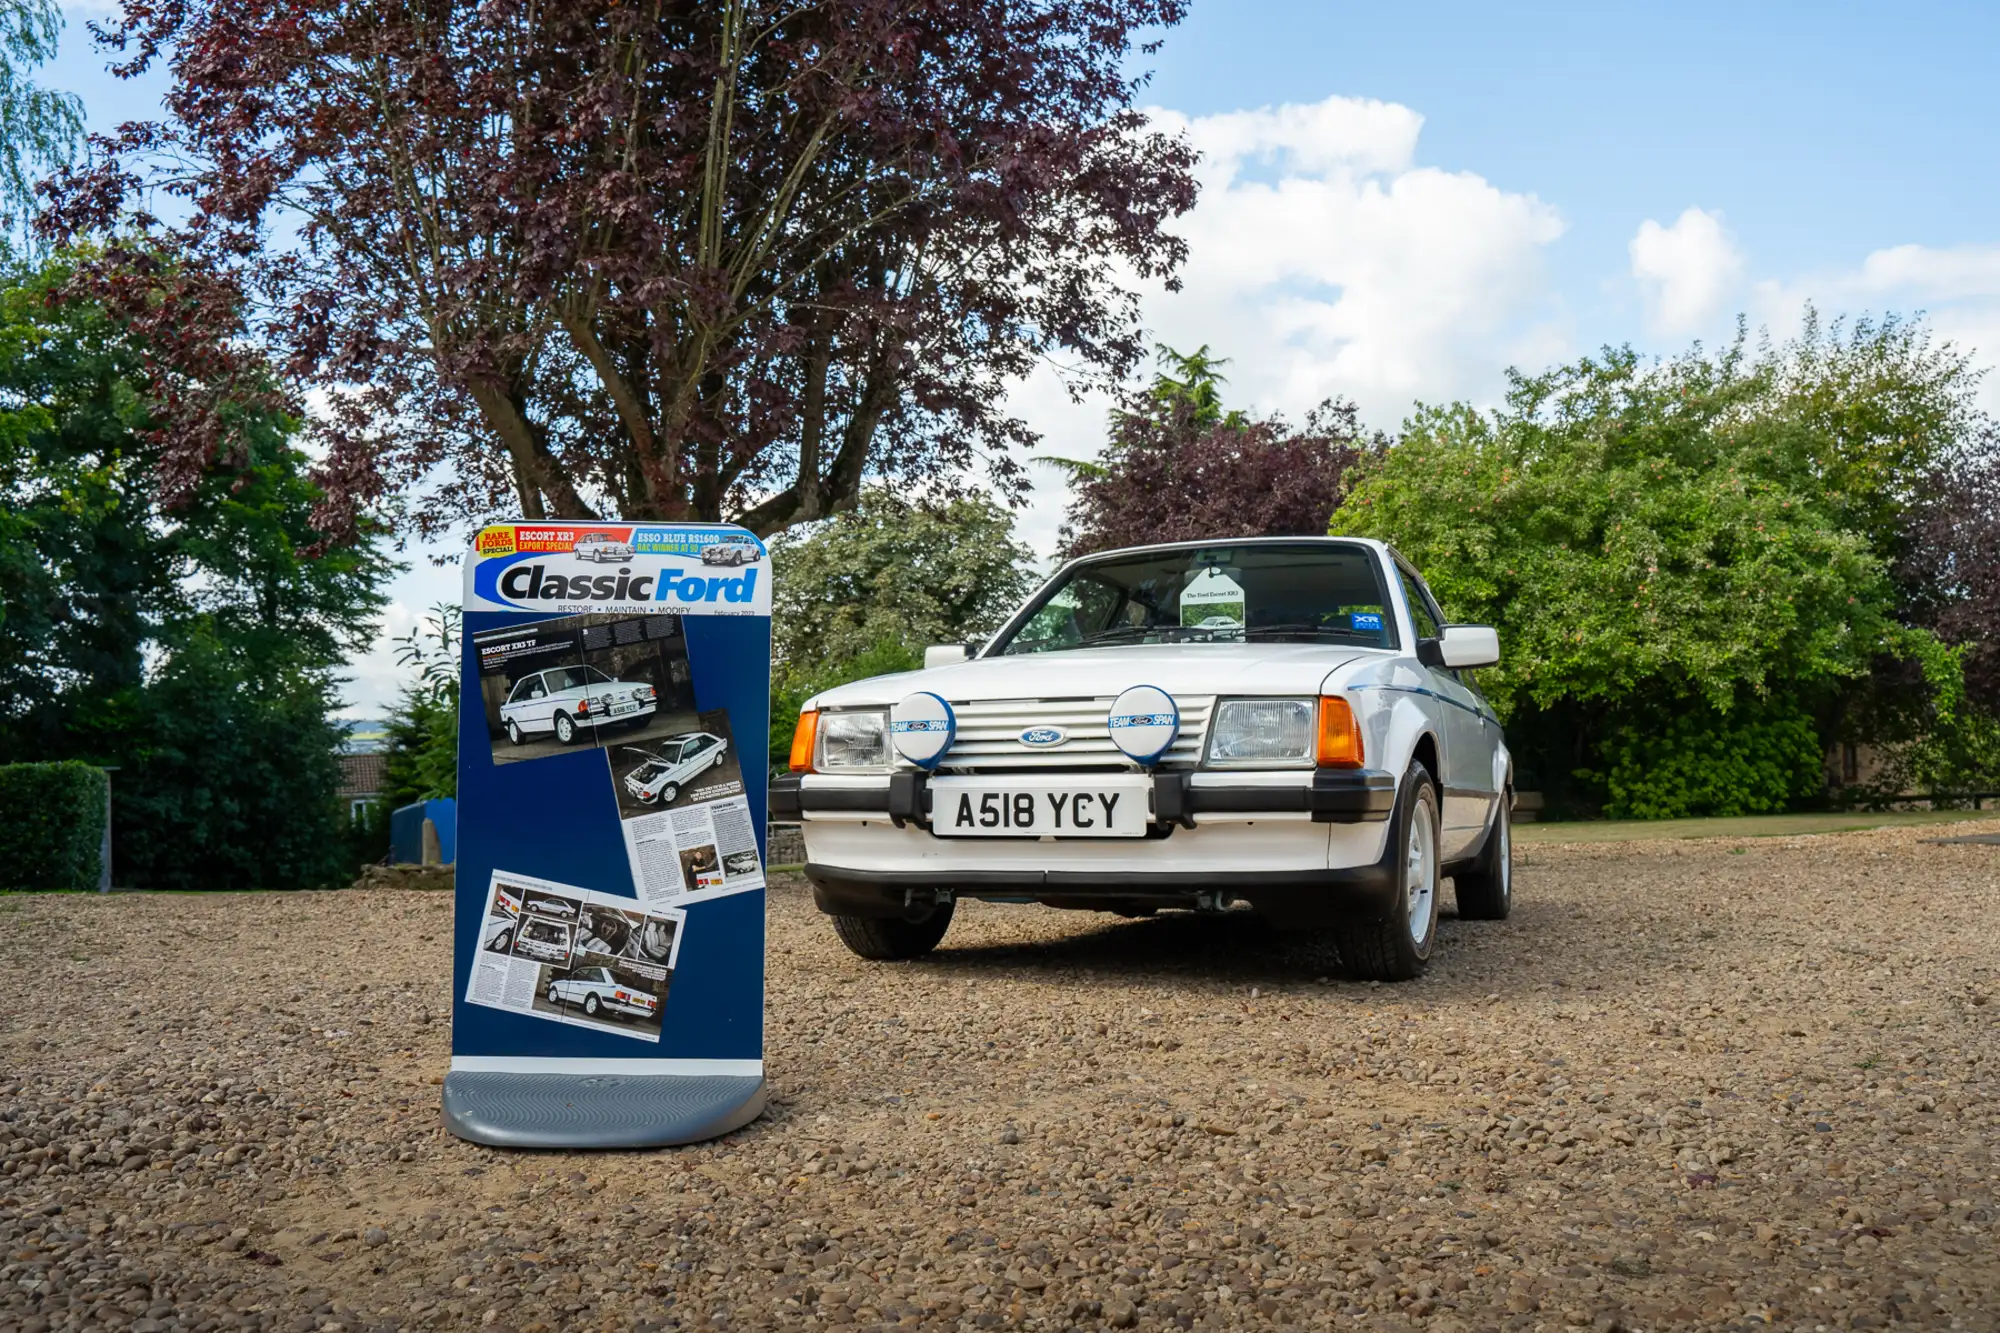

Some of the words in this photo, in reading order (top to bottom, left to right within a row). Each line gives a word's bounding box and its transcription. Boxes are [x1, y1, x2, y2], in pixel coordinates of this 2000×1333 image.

[484, 532, 510, 540] RARE
[519, 531, 555, 541] ESCORT
[556, 532, 575, 541] XR3
[637, 533, 661, 543] ESSO
[662, 533, 687, 543] BLUE
[688, 534, 720, 544] RS1600
[482, 539, 512, 548] FORDS
[519, 541, 545, 550] EXPORT
[546, 541, 573, 551] SPECIAL
[637, 543, 651, 552] RAC
[652, 543, 679, 552] WINNER
[680, 544, 689, 552] AT
[501, 564, 654, 601] Classic
[655, 568, 759, 603] Ford
[557, 604, 593, 613] RESTORE
[605, 606, 647, 614] MAINTAIN
[657, 607, 691, 615] MODIFY
[481, 643, 511, 655] ESCORT
[511, 641, 526, 650] XR3
[891, 721, 908, 732] TEAM
[909, 722, 926, 730] Ford
[928, 719, 948, 731] SPAN
[1109, 716, 1130, 728] TEAM
[1135, 716, 1150, 725] Ford
[1153, 714, 1174, 725] SPAN
[1028, 731, 1054, 743] Ford
[955, 793, 1035, 828] A518
[1047, 793, 1120, 828] YCY
